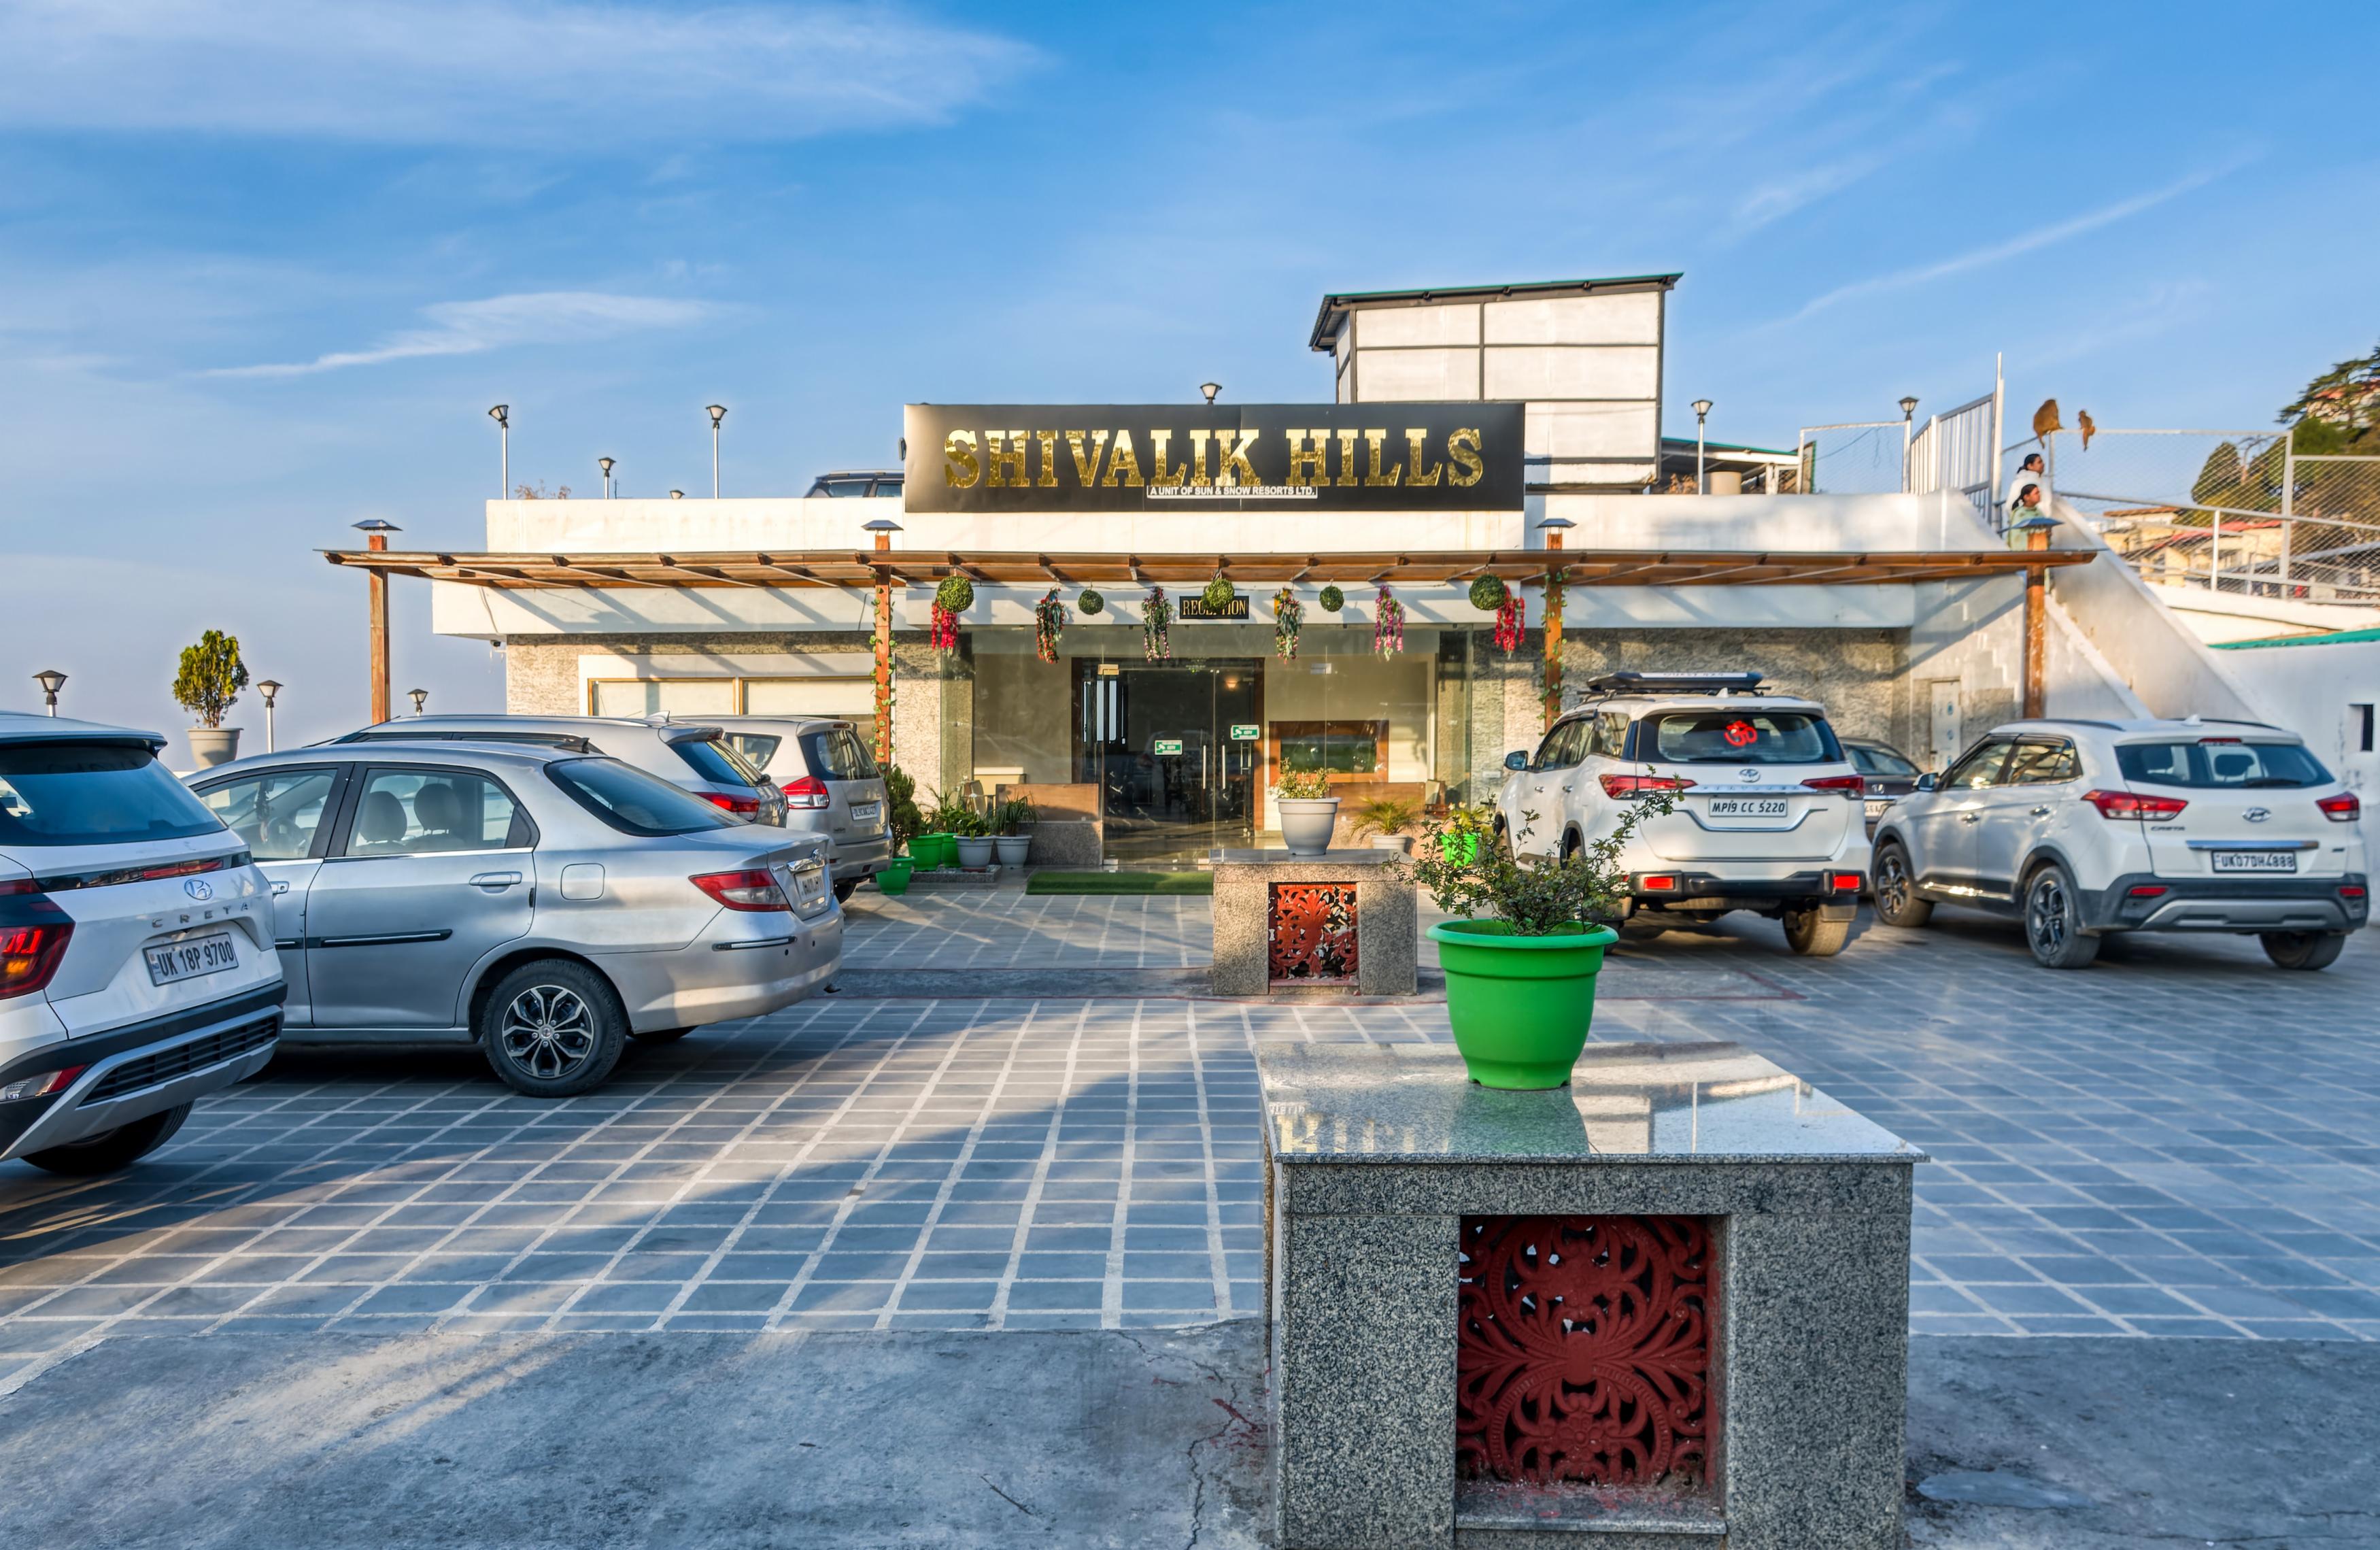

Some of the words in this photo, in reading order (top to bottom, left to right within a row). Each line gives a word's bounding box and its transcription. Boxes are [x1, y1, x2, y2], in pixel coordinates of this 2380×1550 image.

[945, 429, 1260, 488] SHIVALIK
[1286, 428, 1483, 487] HILLS
[1150, 486, 1157, 495] A
[1158, 486, 1179, 495] UNIT
[1180, 486, 1193, 495] OF
[1194, 486, 1213, 495] SUN
[1214, 486, 1222, 495] &
[1223, 486, 1251, 495] SNOW
[1252, 486, 1294, 495] RESORTS
[1712, 802, 1737, 813] MP19
[1741, 802, 1754, 813] CC
[1758, 802, 1786, 813] 5220
[152, 903, 249, 928] CRETA
[157, 951, 178, 977] UK
[180, 947, 201, 972] 18P
[204, 941, 234, 966] 9700
